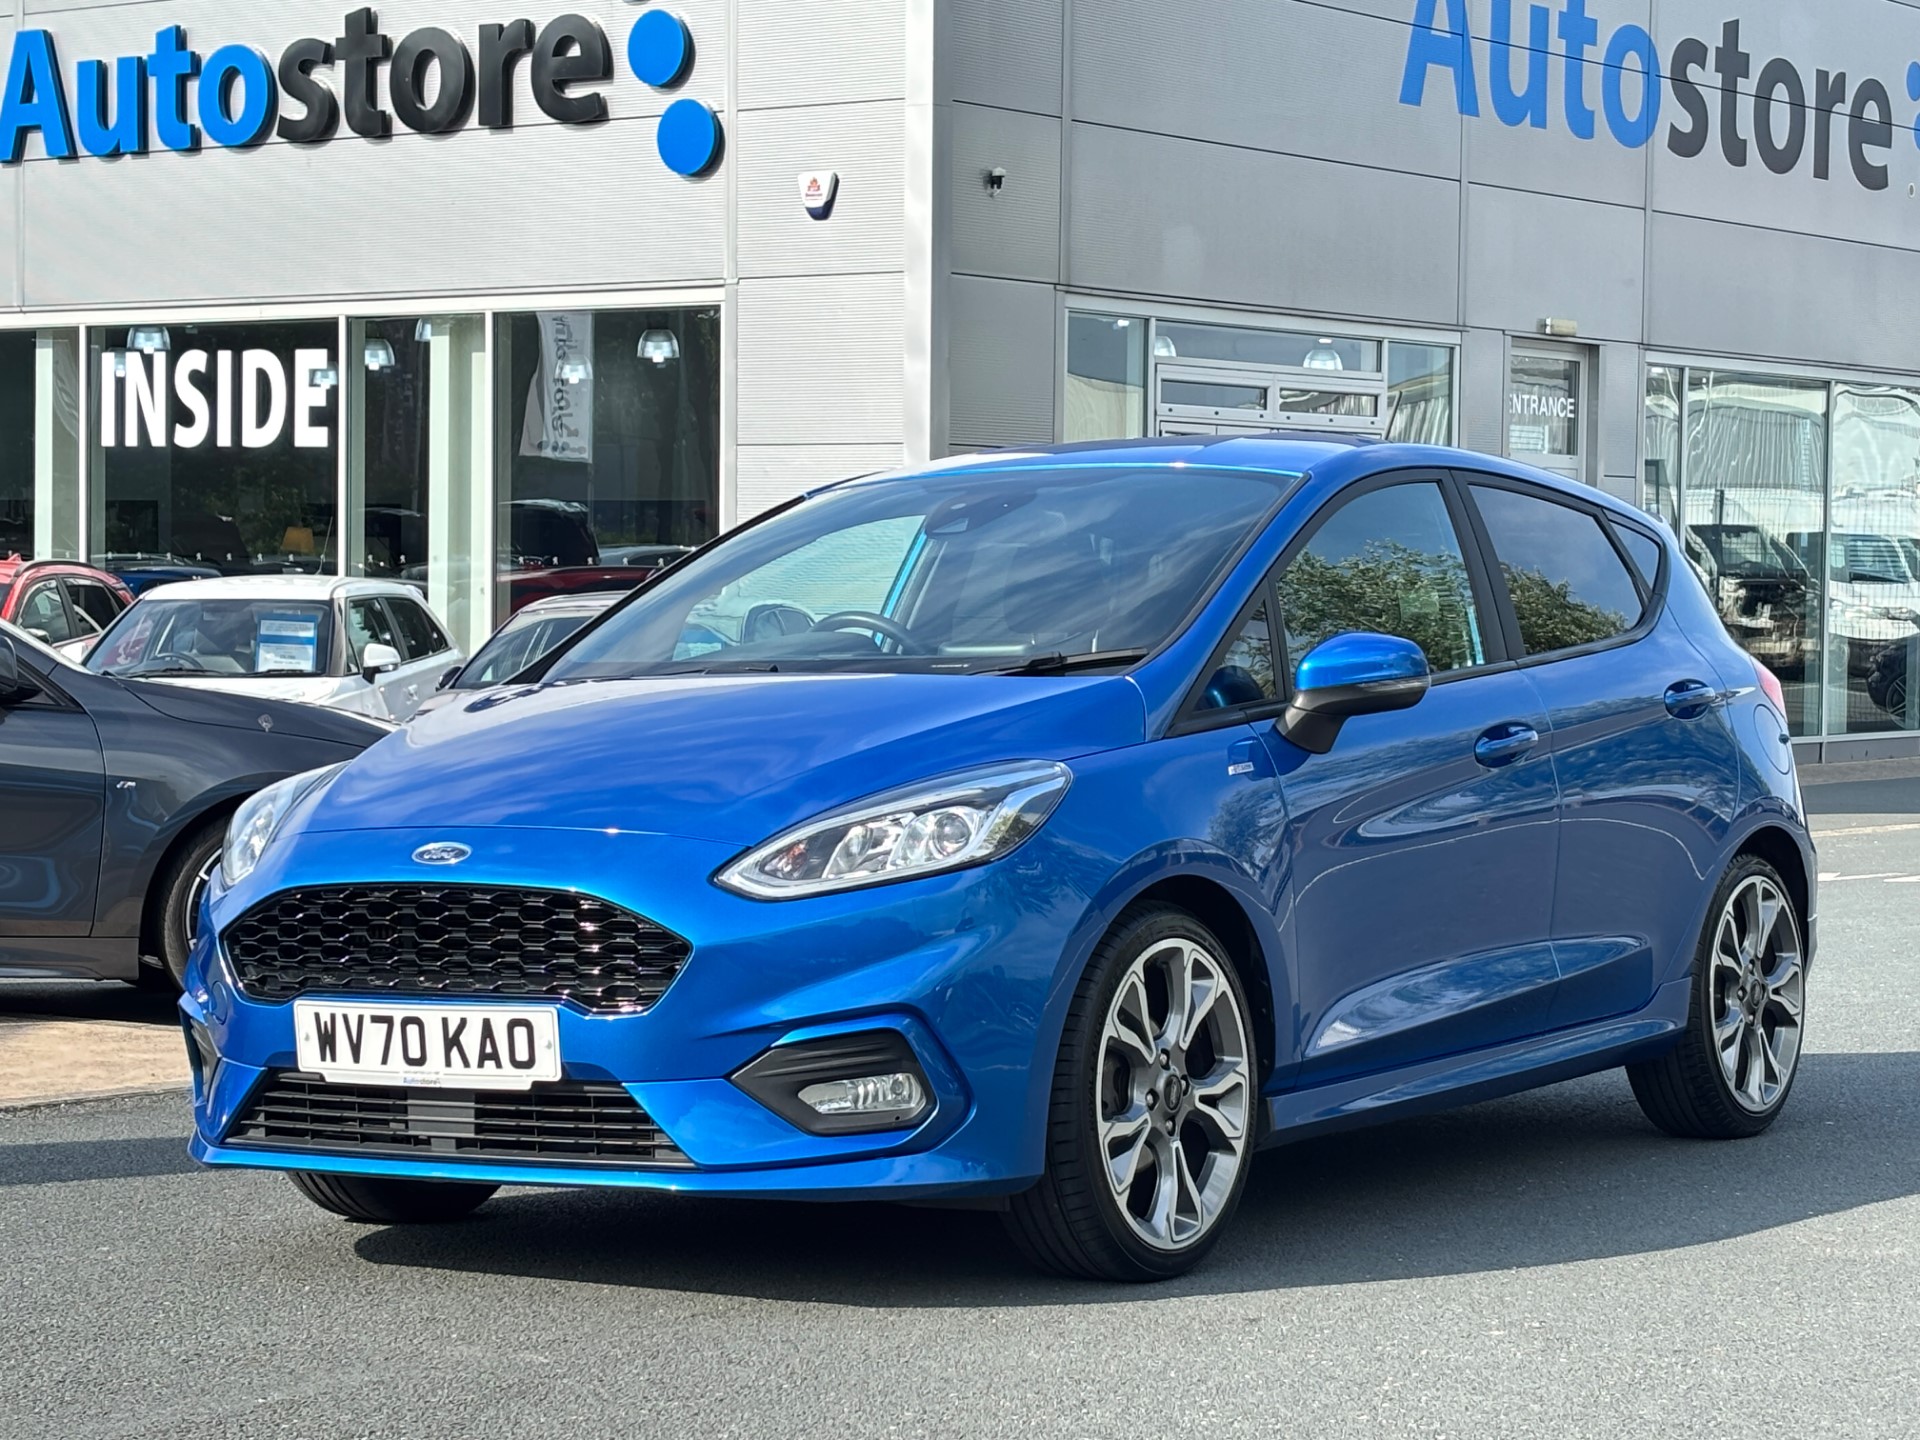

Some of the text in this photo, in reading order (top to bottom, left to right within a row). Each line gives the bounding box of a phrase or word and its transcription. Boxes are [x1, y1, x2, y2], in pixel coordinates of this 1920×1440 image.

[0, 8, 611, 162] Autostore
[1399, 0, 1893, 190] Autostore
[101, 348, 329, 449] INSIDE
[1509, 393, 1575, 418] NTRANCE
[314, 1011, 536, 1069] WV70 KAO
